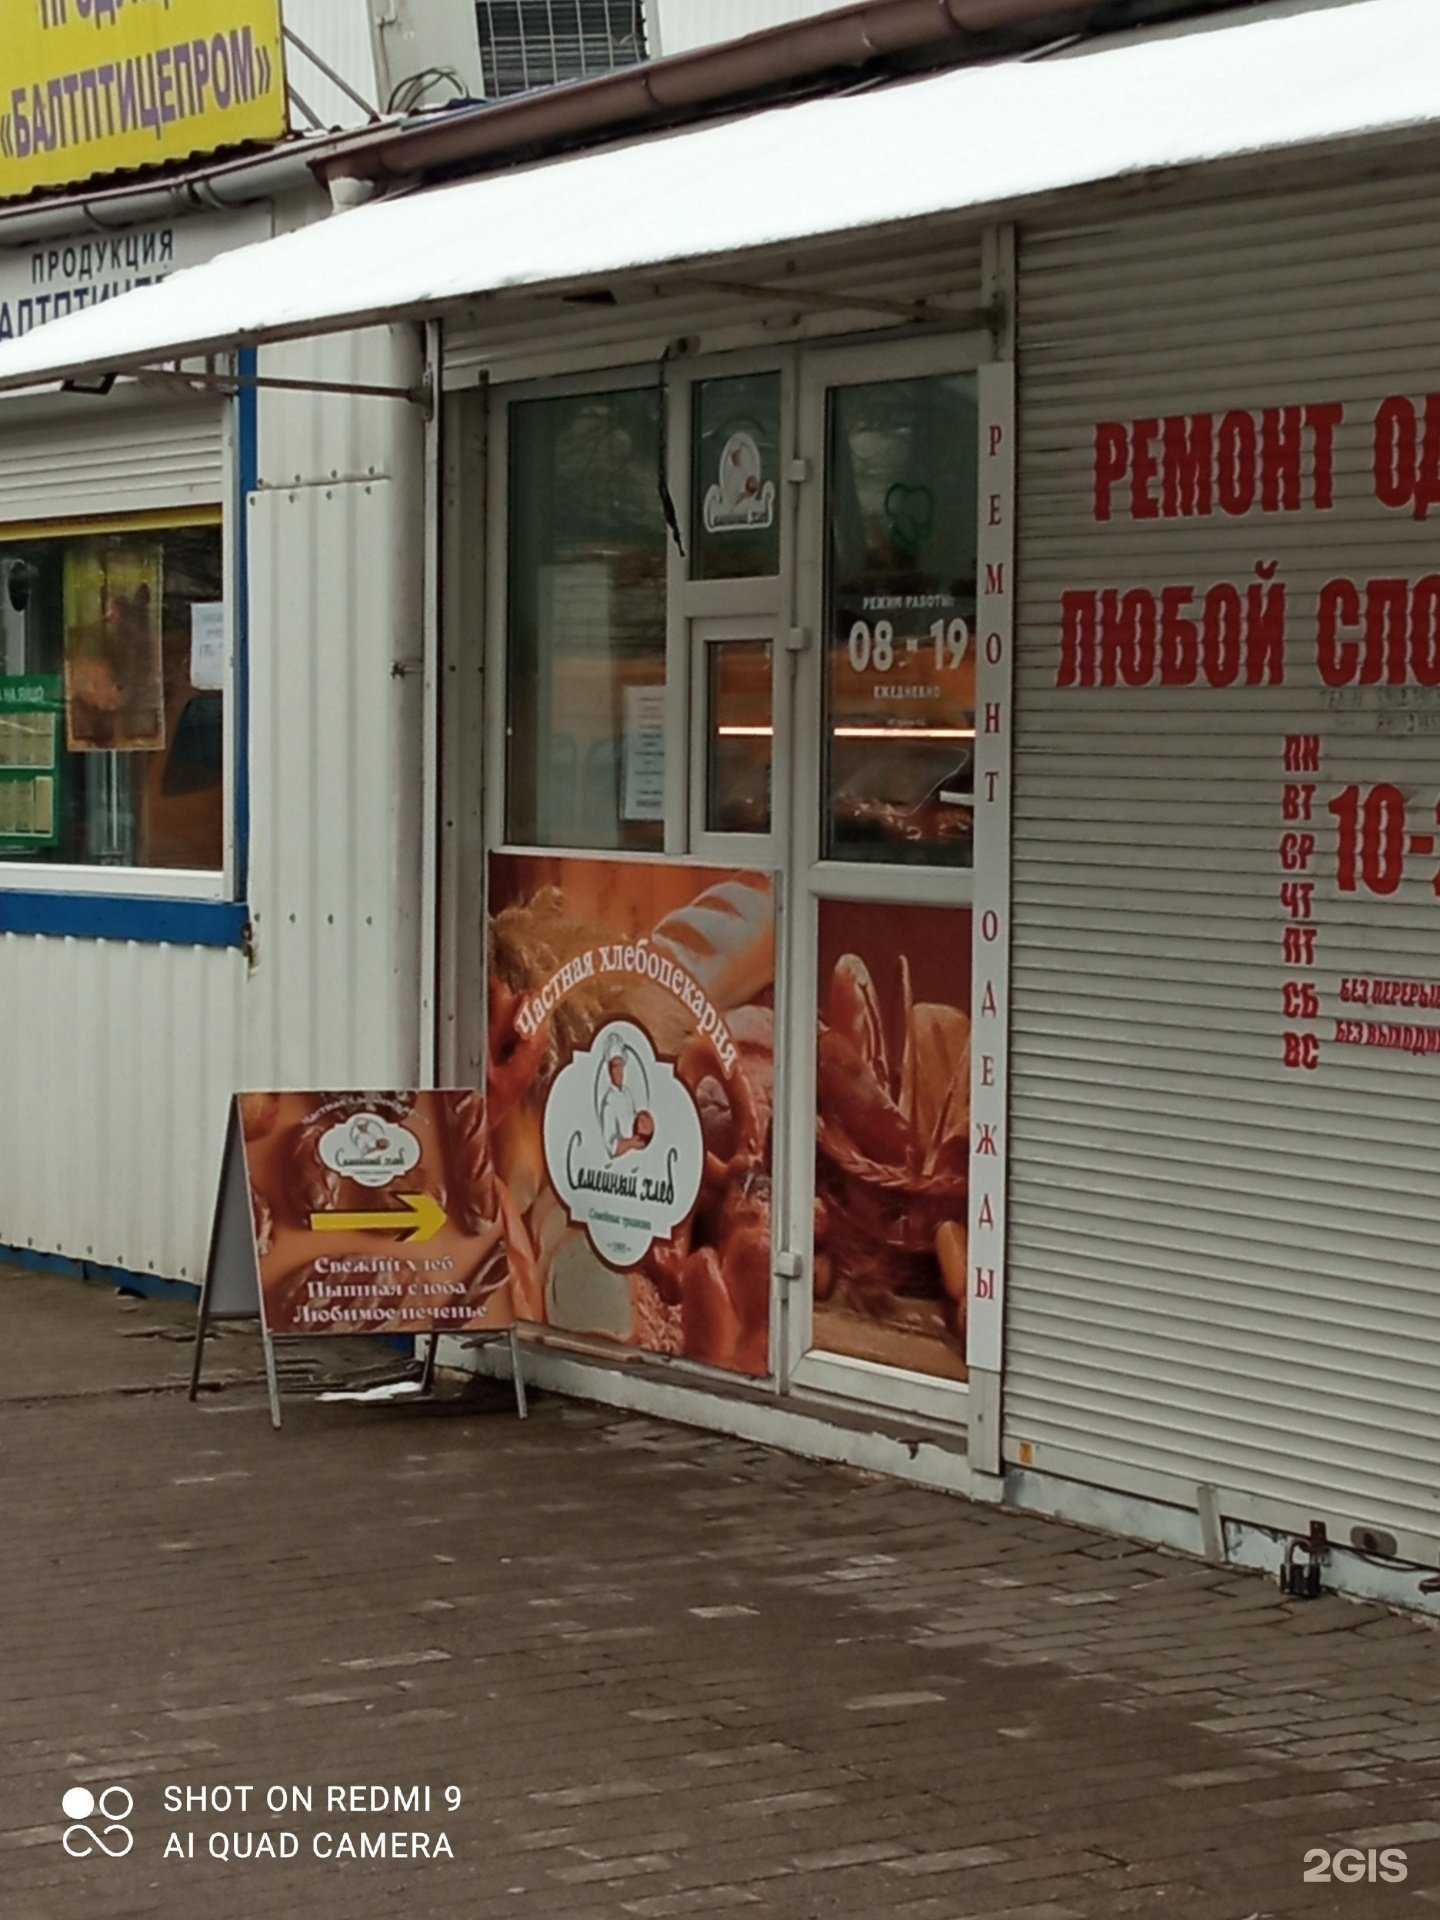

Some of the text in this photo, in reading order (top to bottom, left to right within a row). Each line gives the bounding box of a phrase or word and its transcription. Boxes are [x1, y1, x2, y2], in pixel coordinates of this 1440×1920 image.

[32, 228, 174, 285] ПРОДУКЦИЯ
[1094, 402, 1344, 521] РЕМОНТ
[984, 424, 1004, 803] РЕМОНТ
[1055, 560, 1440, 688] ЛЮБОЙ СЛО
[848, 619, 894, 673] 08
[930, 616, 969, 671] 19
[1284, 735, 1319, 772] ПН
[1283, 784, 1316, 821] ВТ
[1280, 833, 1315, 870] СР
[1280, 883, 1315, 919] ЧТ
[1283, 928, 1317, 965] ПТ
[598, 938, 738, 1078] хлебопекарня
[1283, 982, 1319, 1019] СБ
[1340, 978, 1369, 1004] БЕЗ
[1283, 1033, 1319, 1070] ВС
[1335, 1020, 1363, 1046] БЕЗ
[566, 1130, 679, 1205] Семейный хлеб
[292, 1304, 396, 1324] Любимое
